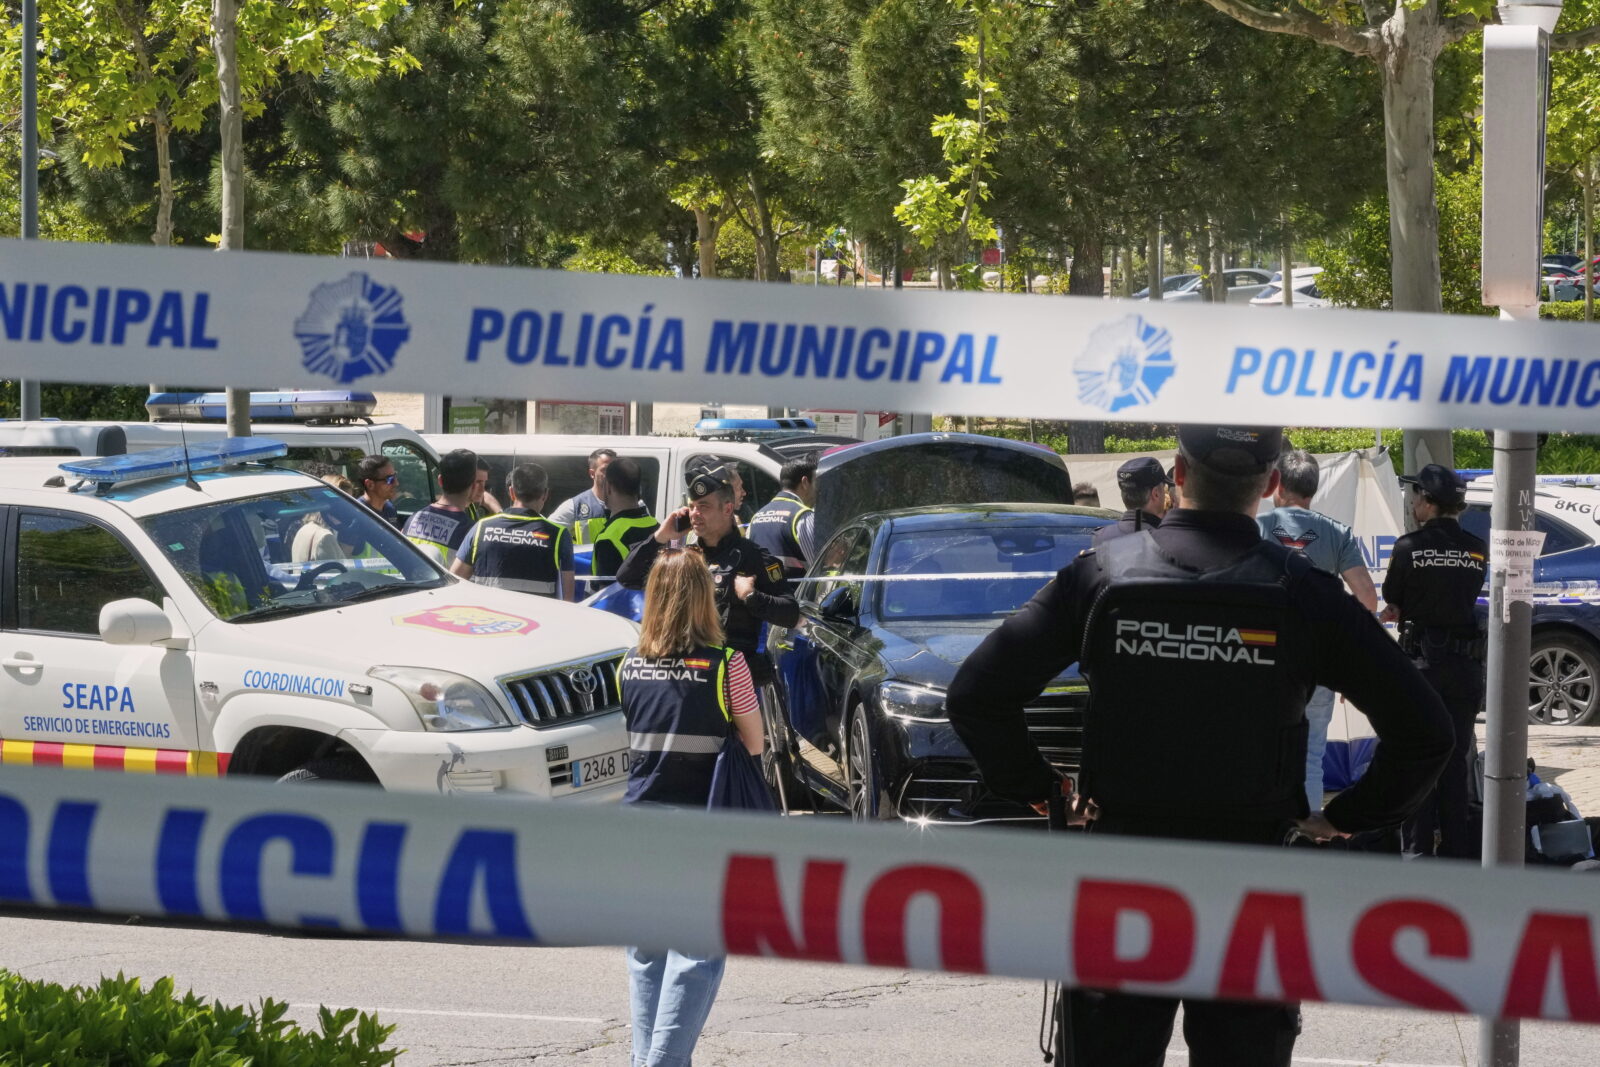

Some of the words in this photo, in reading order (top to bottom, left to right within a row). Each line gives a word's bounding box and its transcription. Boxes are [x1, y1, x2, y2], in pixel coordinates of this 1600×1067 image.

[465, 304, 685, 372] POLICÍA
[705, 320, 1003, 384] MUNICIPAL
[1225, 341, 1424, 402] POLICÍA
[1554, 500, 1592, 514] 8KG
[483, 535, 549, 548] NACIONAL
[484, 527, 535, 538] POLICIA
[1411, 549, 1471, 559] POLICIA
[1412, 559, 1483, 570] NACIONAL
[1116, 619, 1244, 645] POLICIA
[624, 657, 686, 669] POLICIA
[1115, 638, 1275, 665] NACIONAL
[243, 669, 344, 697] COORDINACION
[622, 669, 708, 682] NACIONAL
[62, 682, 135, 713] SEAPA
[23, 716, 73, 732] SERVICIO
[75, 718, 90, 733] DE
[92, 719, 170, 739] EMERGENCIAS
[583, 756, 616, 782] 2348
